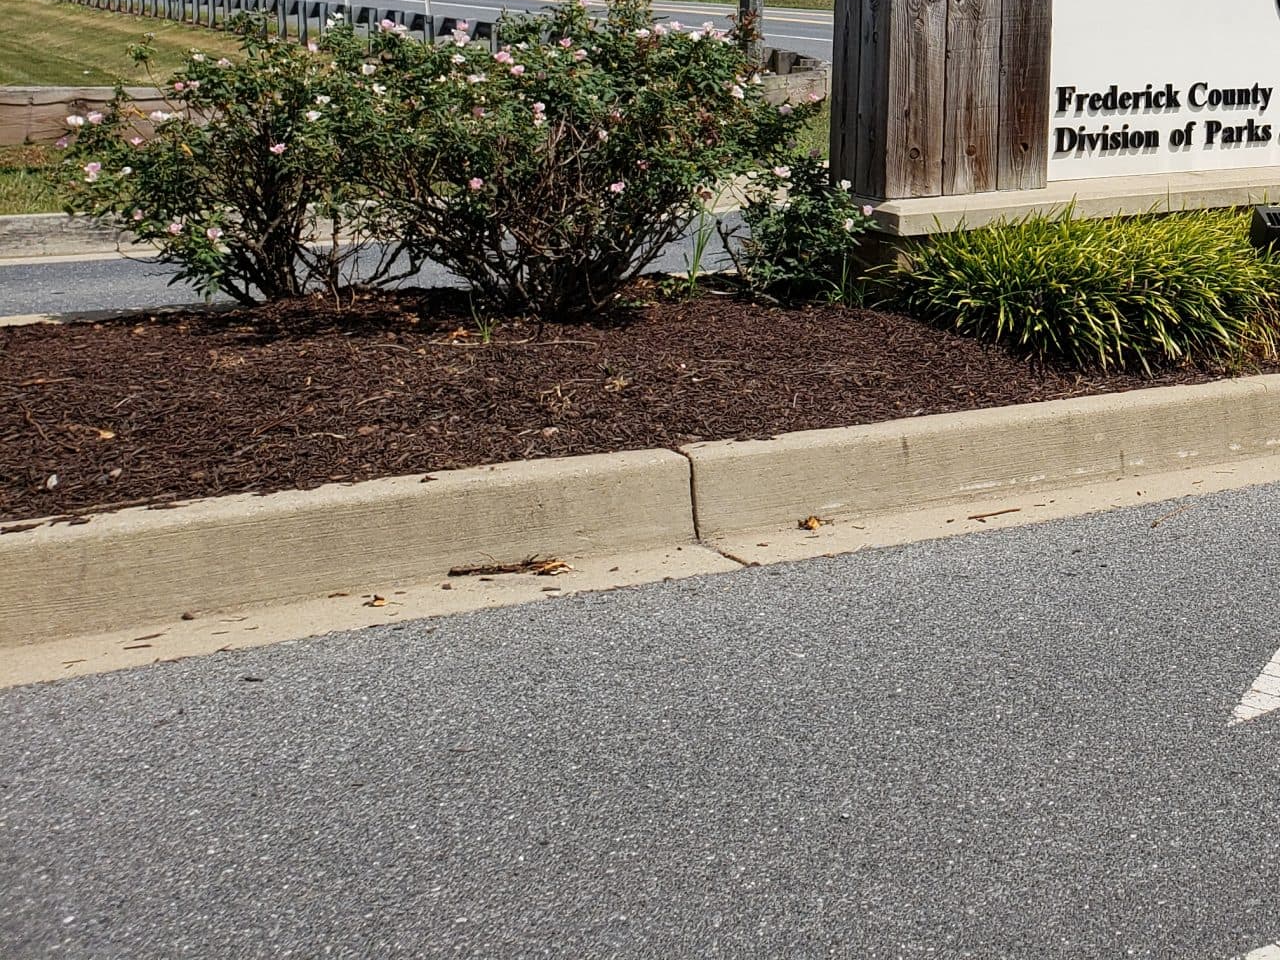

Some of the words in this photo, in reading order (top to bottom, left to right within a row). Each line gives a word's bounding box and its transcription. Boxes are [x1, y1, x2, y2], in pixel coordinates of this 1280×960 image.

[1055, 83, 1181, 114] Frederick
[1187, 82, 1274, 112] County
[1054, 124, 1160, 154] Division
[1169, 120, 1197, 147] of
[1204, 118, 1272, 145] Parks
